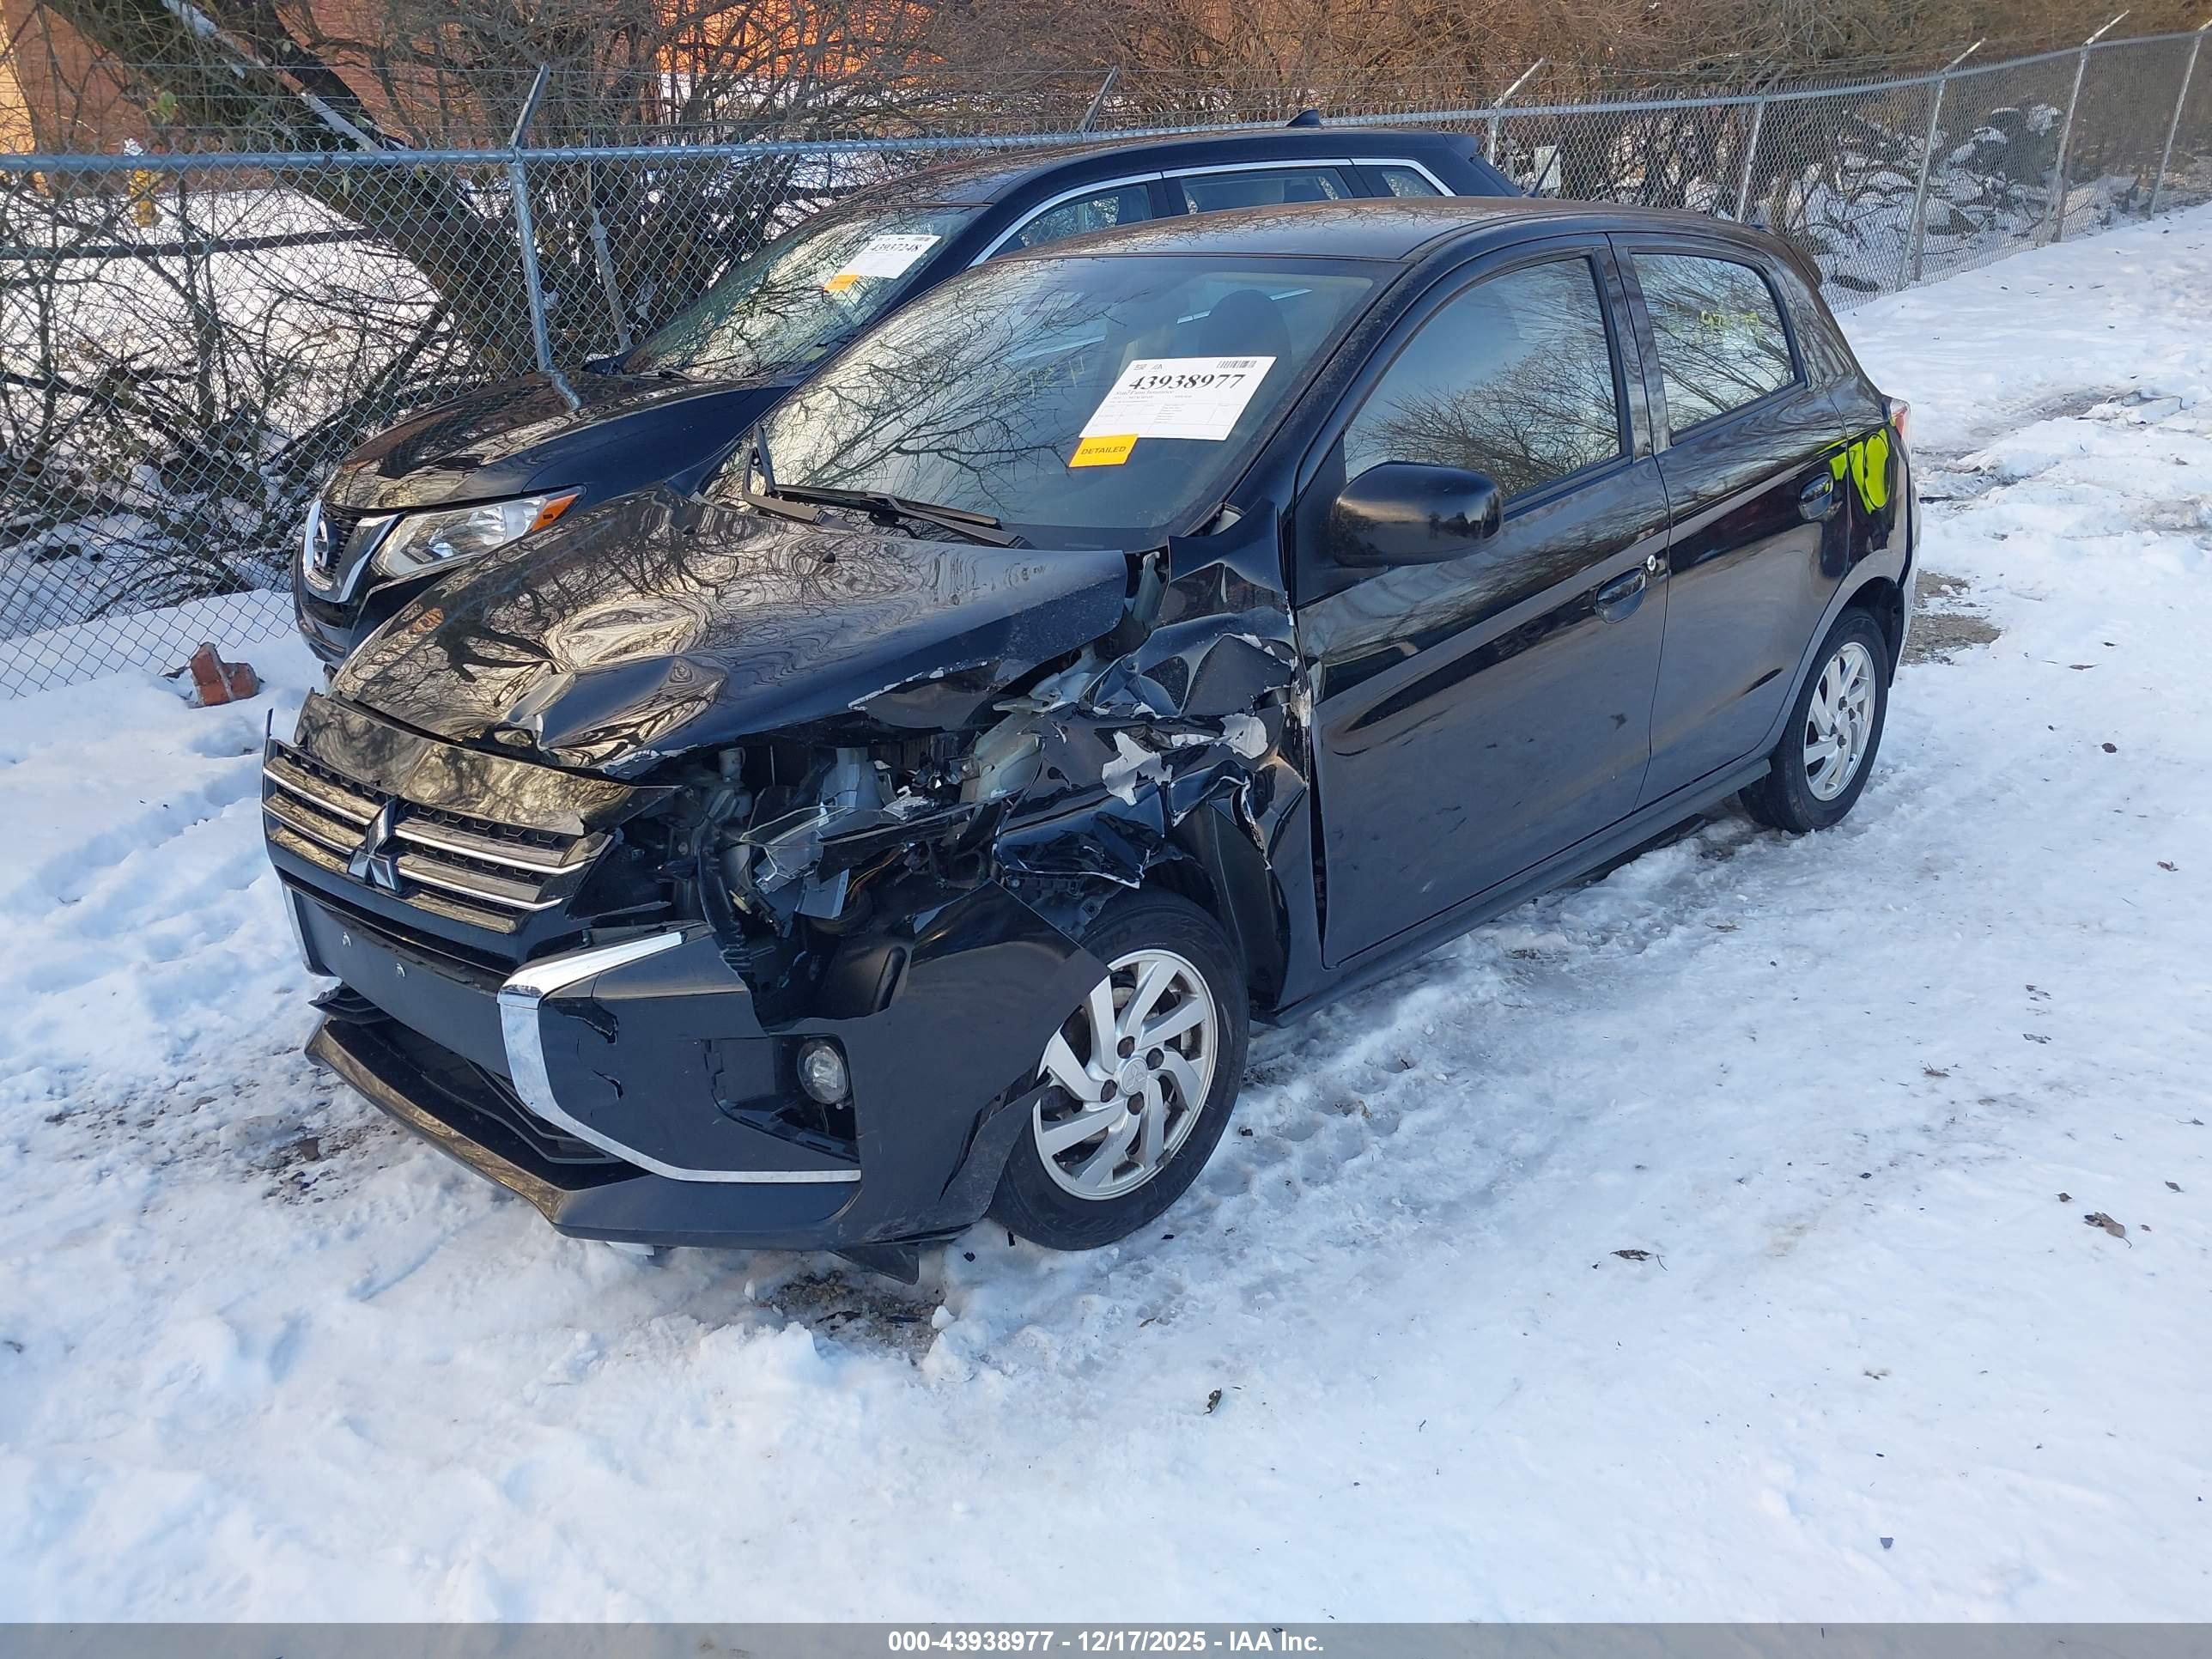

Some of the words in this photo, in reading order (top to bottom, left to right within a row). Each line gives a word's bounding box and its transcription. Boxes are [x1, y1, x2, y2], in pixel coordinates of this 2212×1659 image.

[870, 243, 922, 252] 43937248
[1128, 374, 1247, 391] 43938977
[1080, 446, 1127, 455] DETAILED
